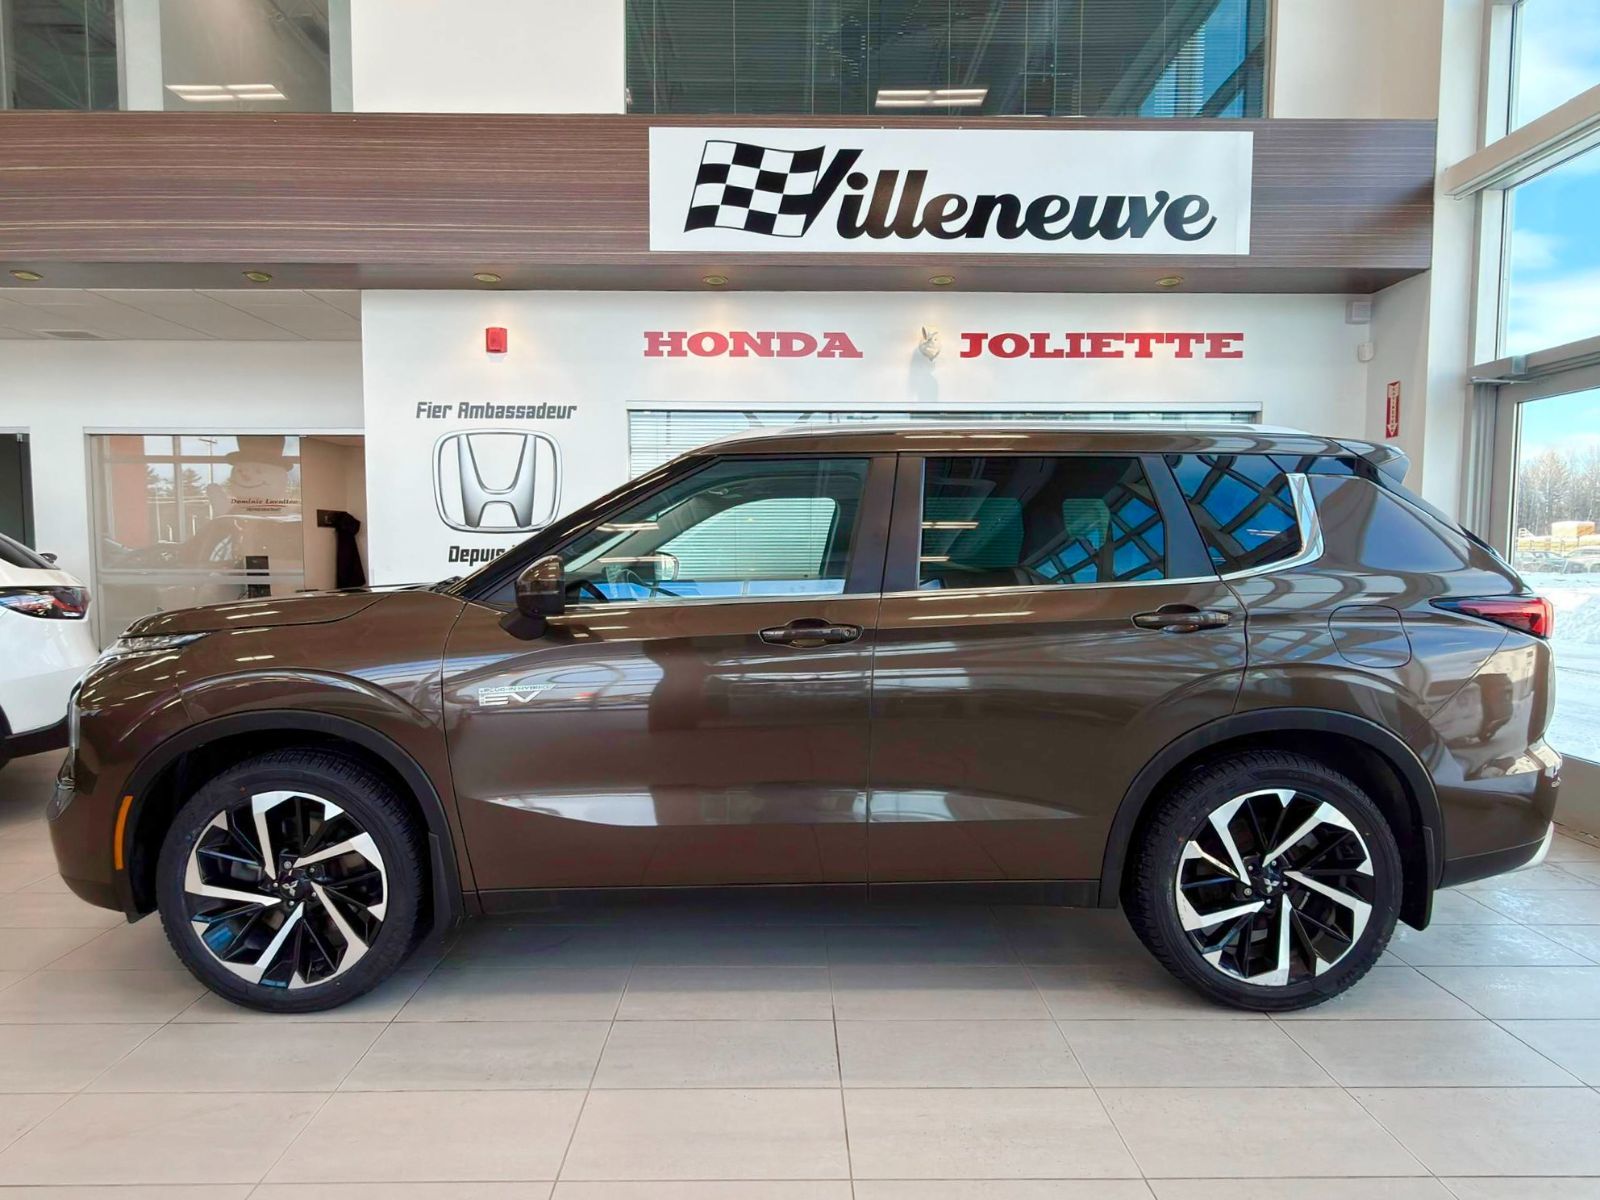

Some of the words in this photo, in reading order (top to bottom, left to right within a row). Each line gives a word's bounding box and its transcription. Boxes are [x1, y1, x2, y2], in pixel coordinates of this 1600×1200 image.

[790, 148, 1217, 242] Villeneuve
[643, 331, 863, 358] HONDA
[959, 332, 1244, 359] JOLIETTE
[416, 402, 453, 419] Fier
[458, 402, 577, 419] Ambassadeur
[479, 690, 542, 706] EV
